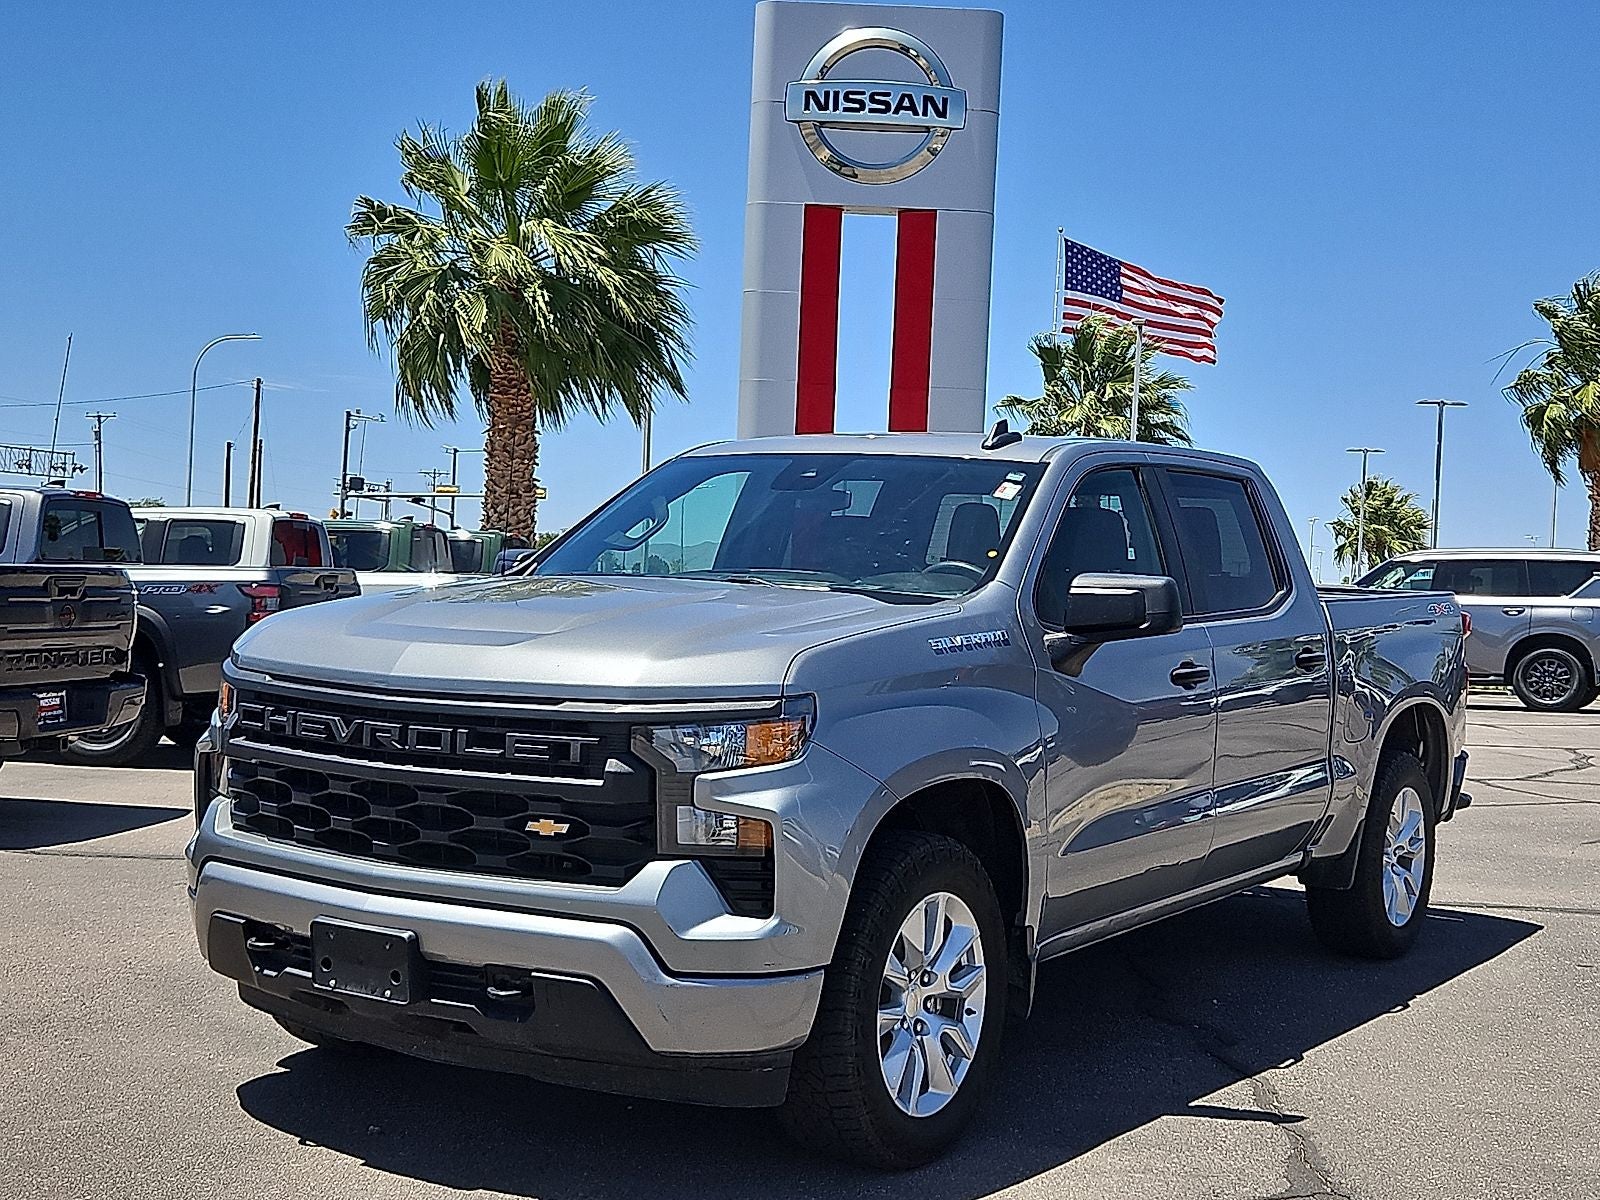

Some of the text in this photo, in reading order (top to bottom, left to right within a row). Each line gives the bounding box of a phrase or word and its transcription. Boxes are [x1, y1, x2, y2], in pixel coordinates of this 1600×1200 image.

[803, 89, 948, 119] NISSAN
[1427, 602, 1454, 616] 4X4
[928, 630, 1009, 650] SILVERADO
[0, 647, 118, 671] RONTIER
[238, 702, 600, 763] CHEVROLET
